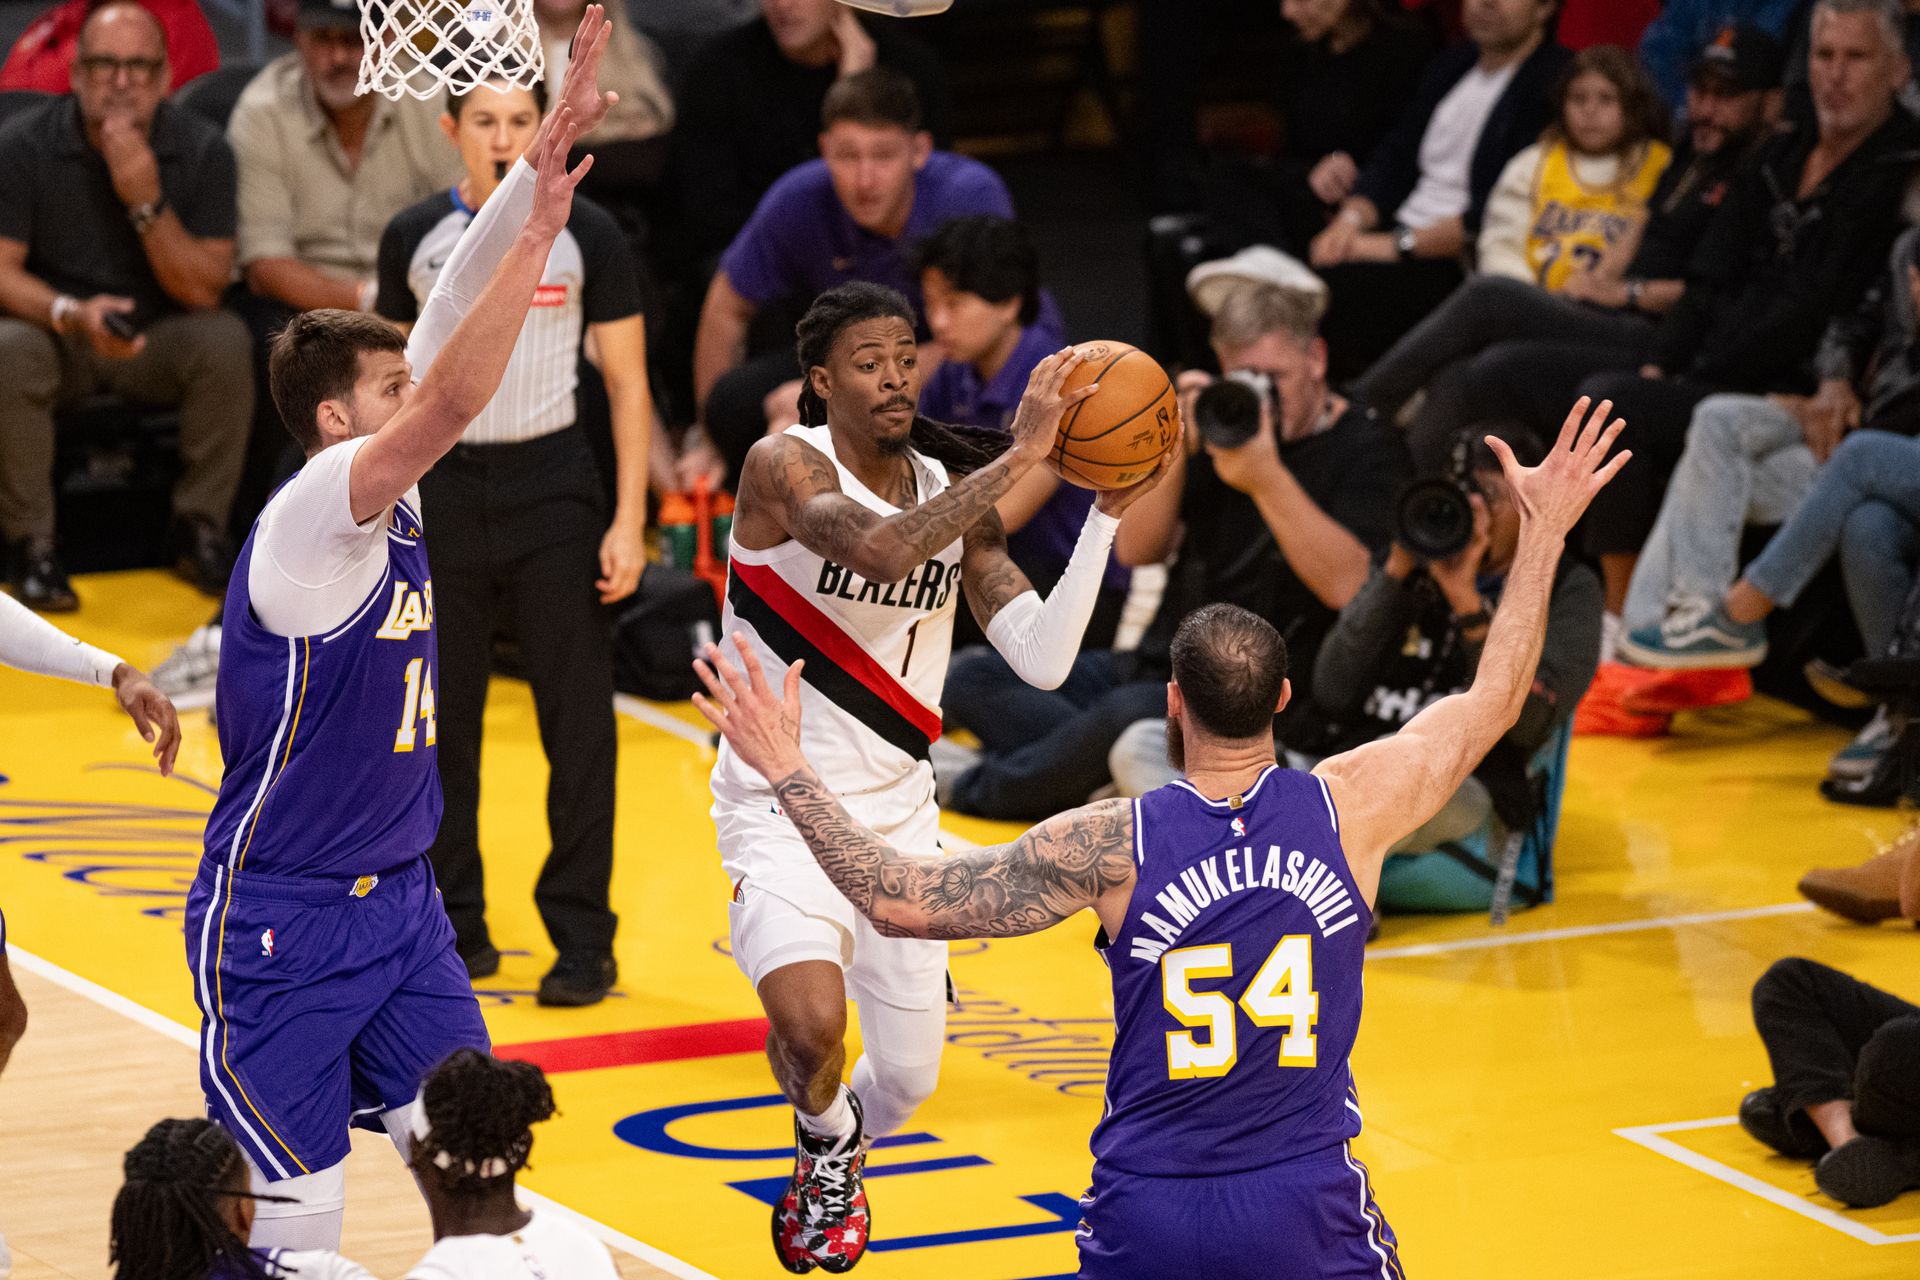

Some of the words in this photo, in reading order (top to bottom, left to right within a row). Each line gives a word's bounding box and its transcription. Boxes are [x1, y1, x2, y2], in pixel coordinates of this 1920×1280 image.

[901, 619, 921, 678] 1
[393, 657, 437, 753] 14
[1130, 845, 1359, 964] MAMUKELASHVILI
[1161, 934, 1319, 1081] 54
